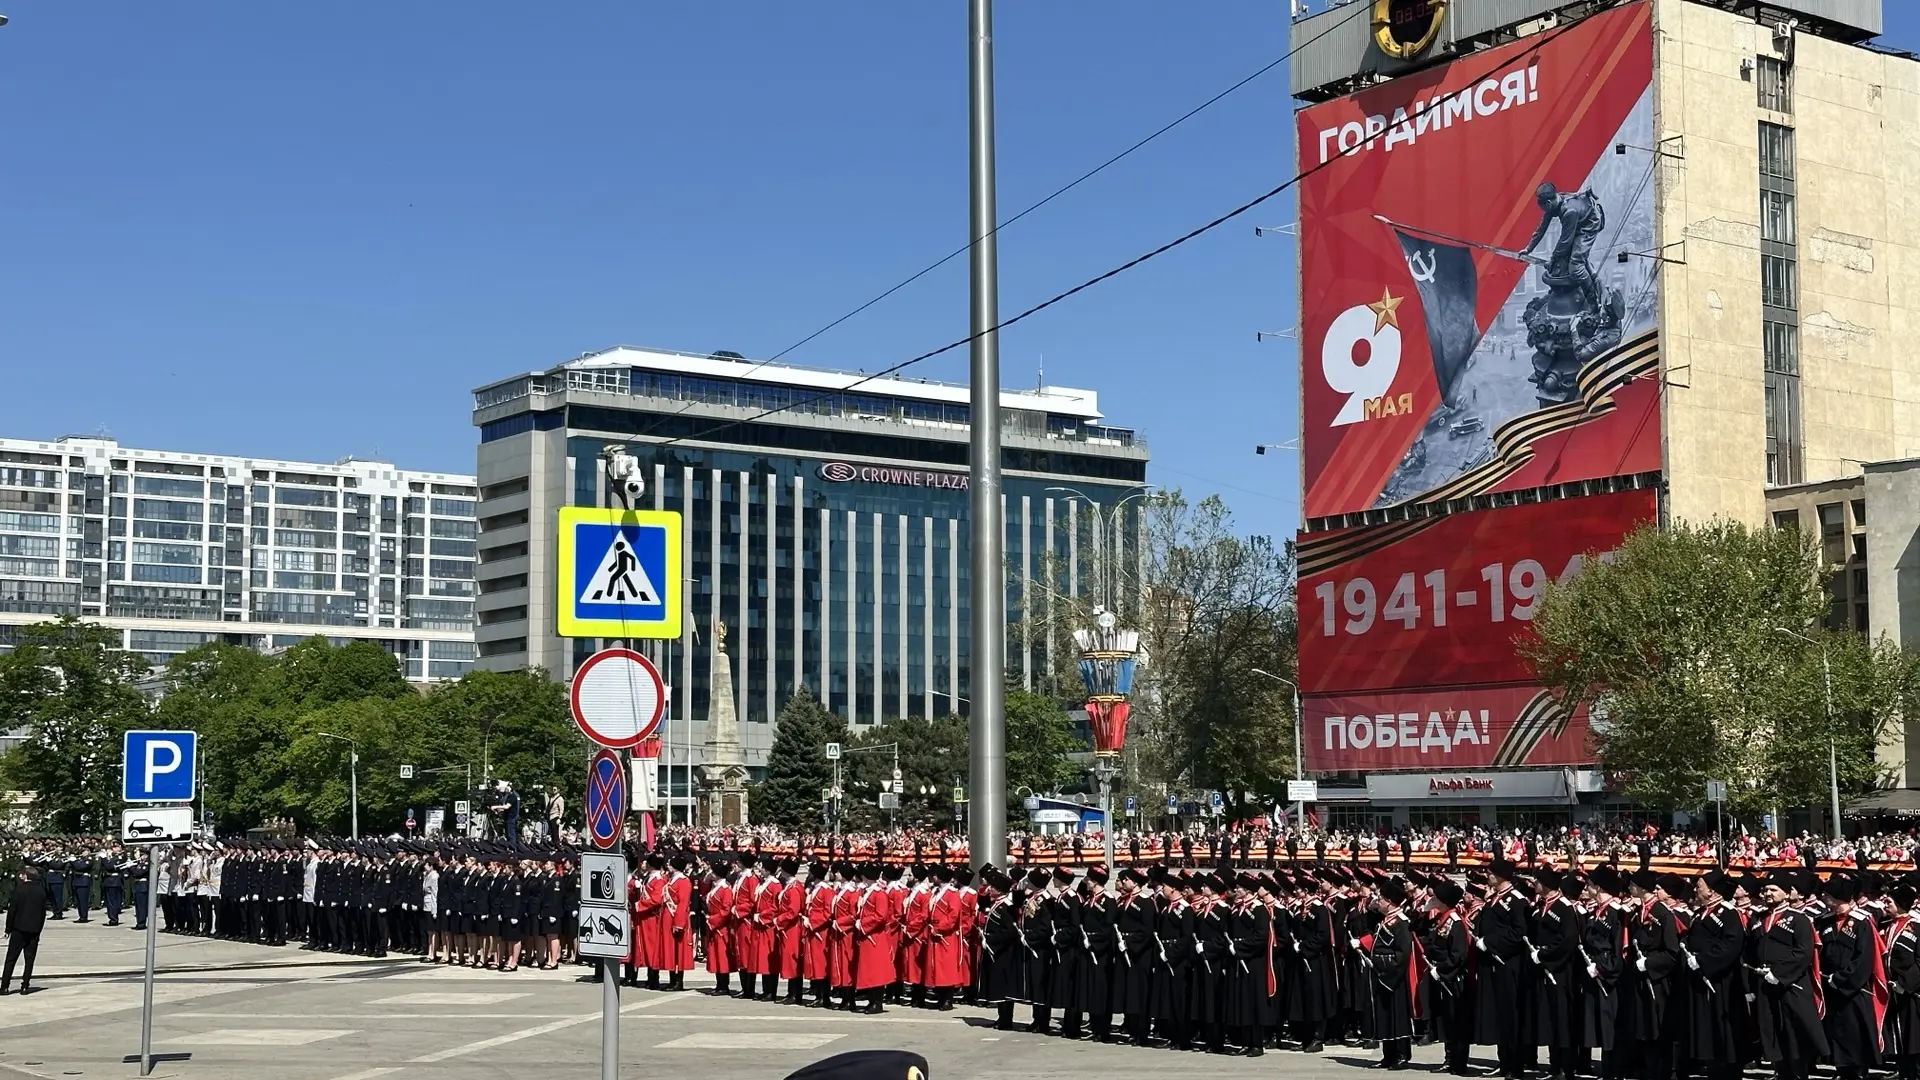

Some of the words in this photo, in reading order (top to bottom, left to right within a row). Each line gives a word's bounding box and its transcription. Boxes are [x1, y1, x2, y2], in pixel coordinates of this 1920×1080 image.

[1319, 64, 1538, 164] ГОРДИМСЯ!
[1322, 303, 1402, 427] 9
[1363, 392, 1413, 421] МАЯ
[861, 467, 921, 486] CROWNE
[926, 473, 969, 490] PLAZA
[1324, 709, 1491, 754] ПОБЕДА!
[144, 740, 182, 793] P
[1429, 777, 1464, 793] Альфа
[1465, 776, 1494, 790] Банк
